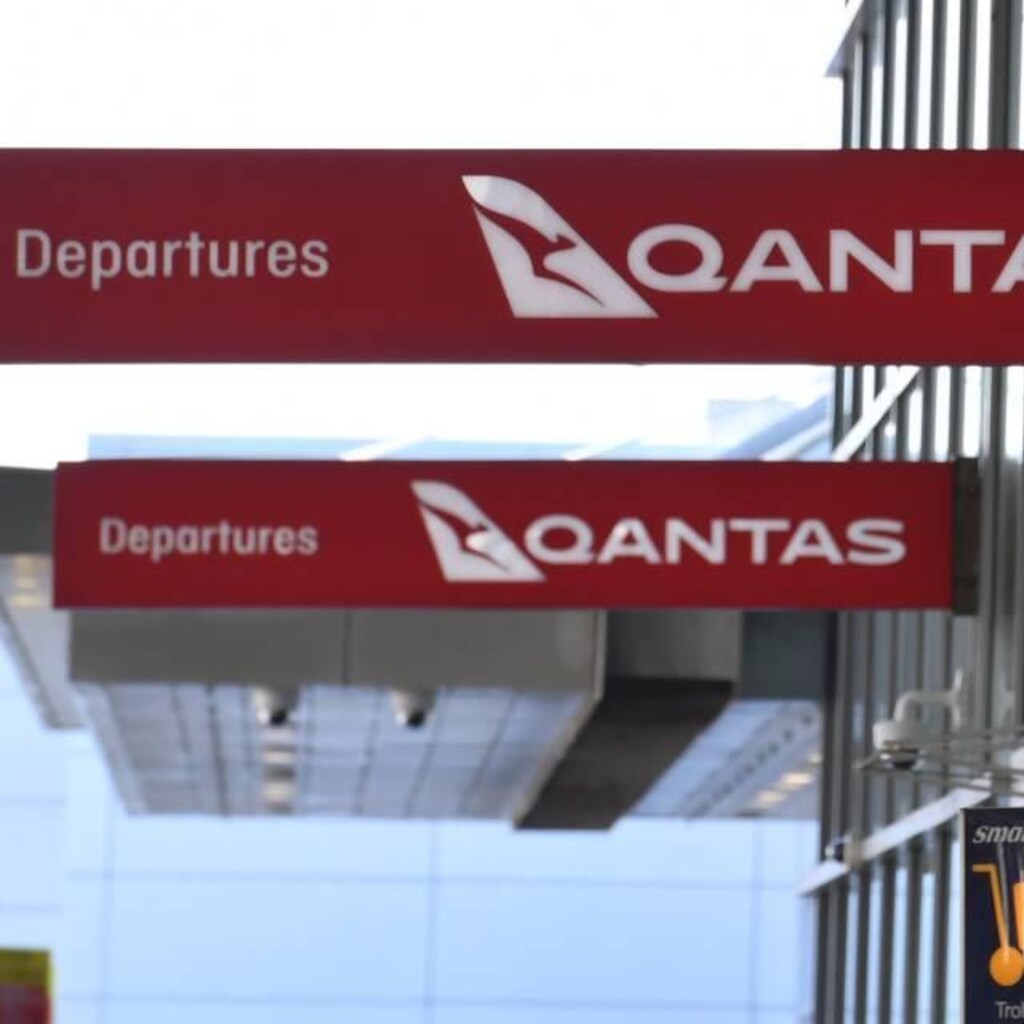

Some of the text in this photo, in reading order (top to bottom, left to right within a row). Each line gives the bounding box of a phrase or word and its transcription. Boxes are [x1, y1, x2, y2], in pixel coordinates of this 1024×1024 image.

[16, 229, 330, 291] Departures
[100, 514, 906, 566] Departures QANTAS
